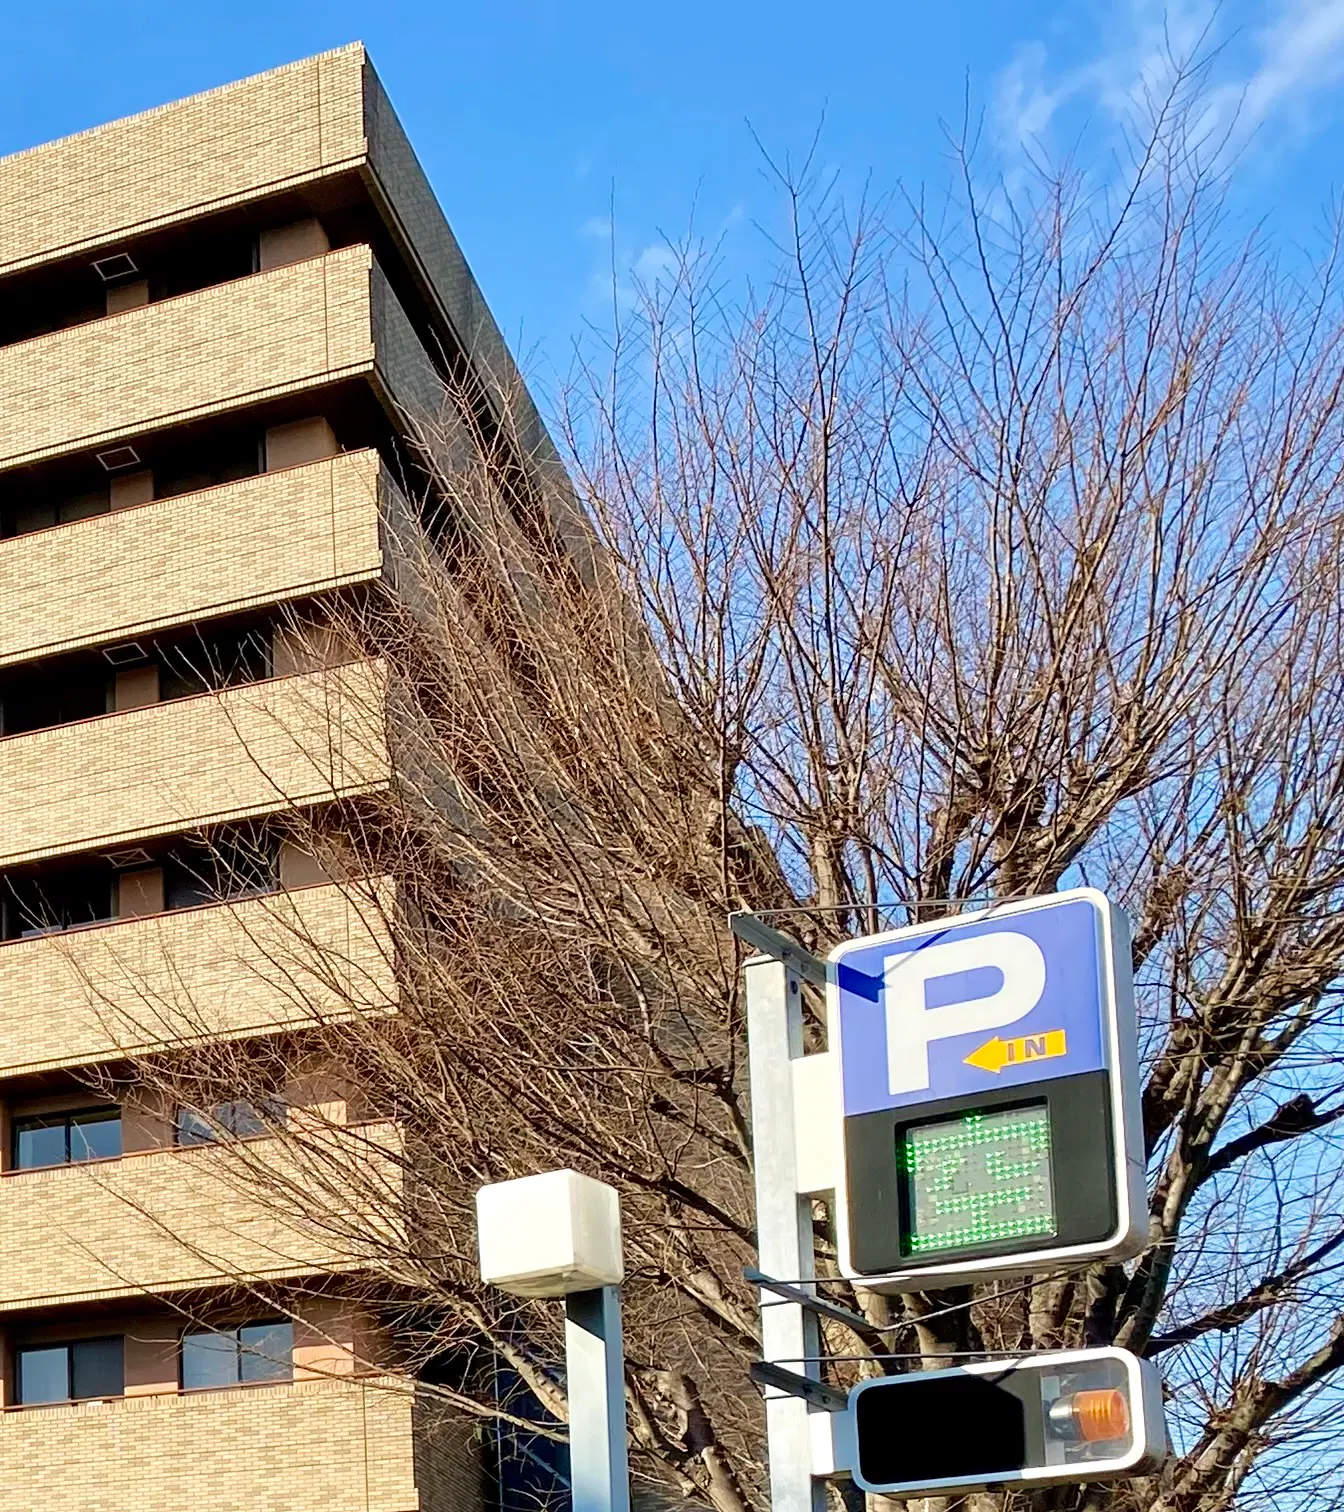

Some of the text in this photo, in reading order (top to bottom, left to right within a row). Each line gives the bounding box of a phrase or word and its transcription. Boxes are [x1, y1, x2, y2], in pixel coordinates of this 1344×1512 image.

[883, 931, 1047, 1096] P
[1007, 1036, 1046, 1064] IN
[904, 1114, 1052, 1251] 空
